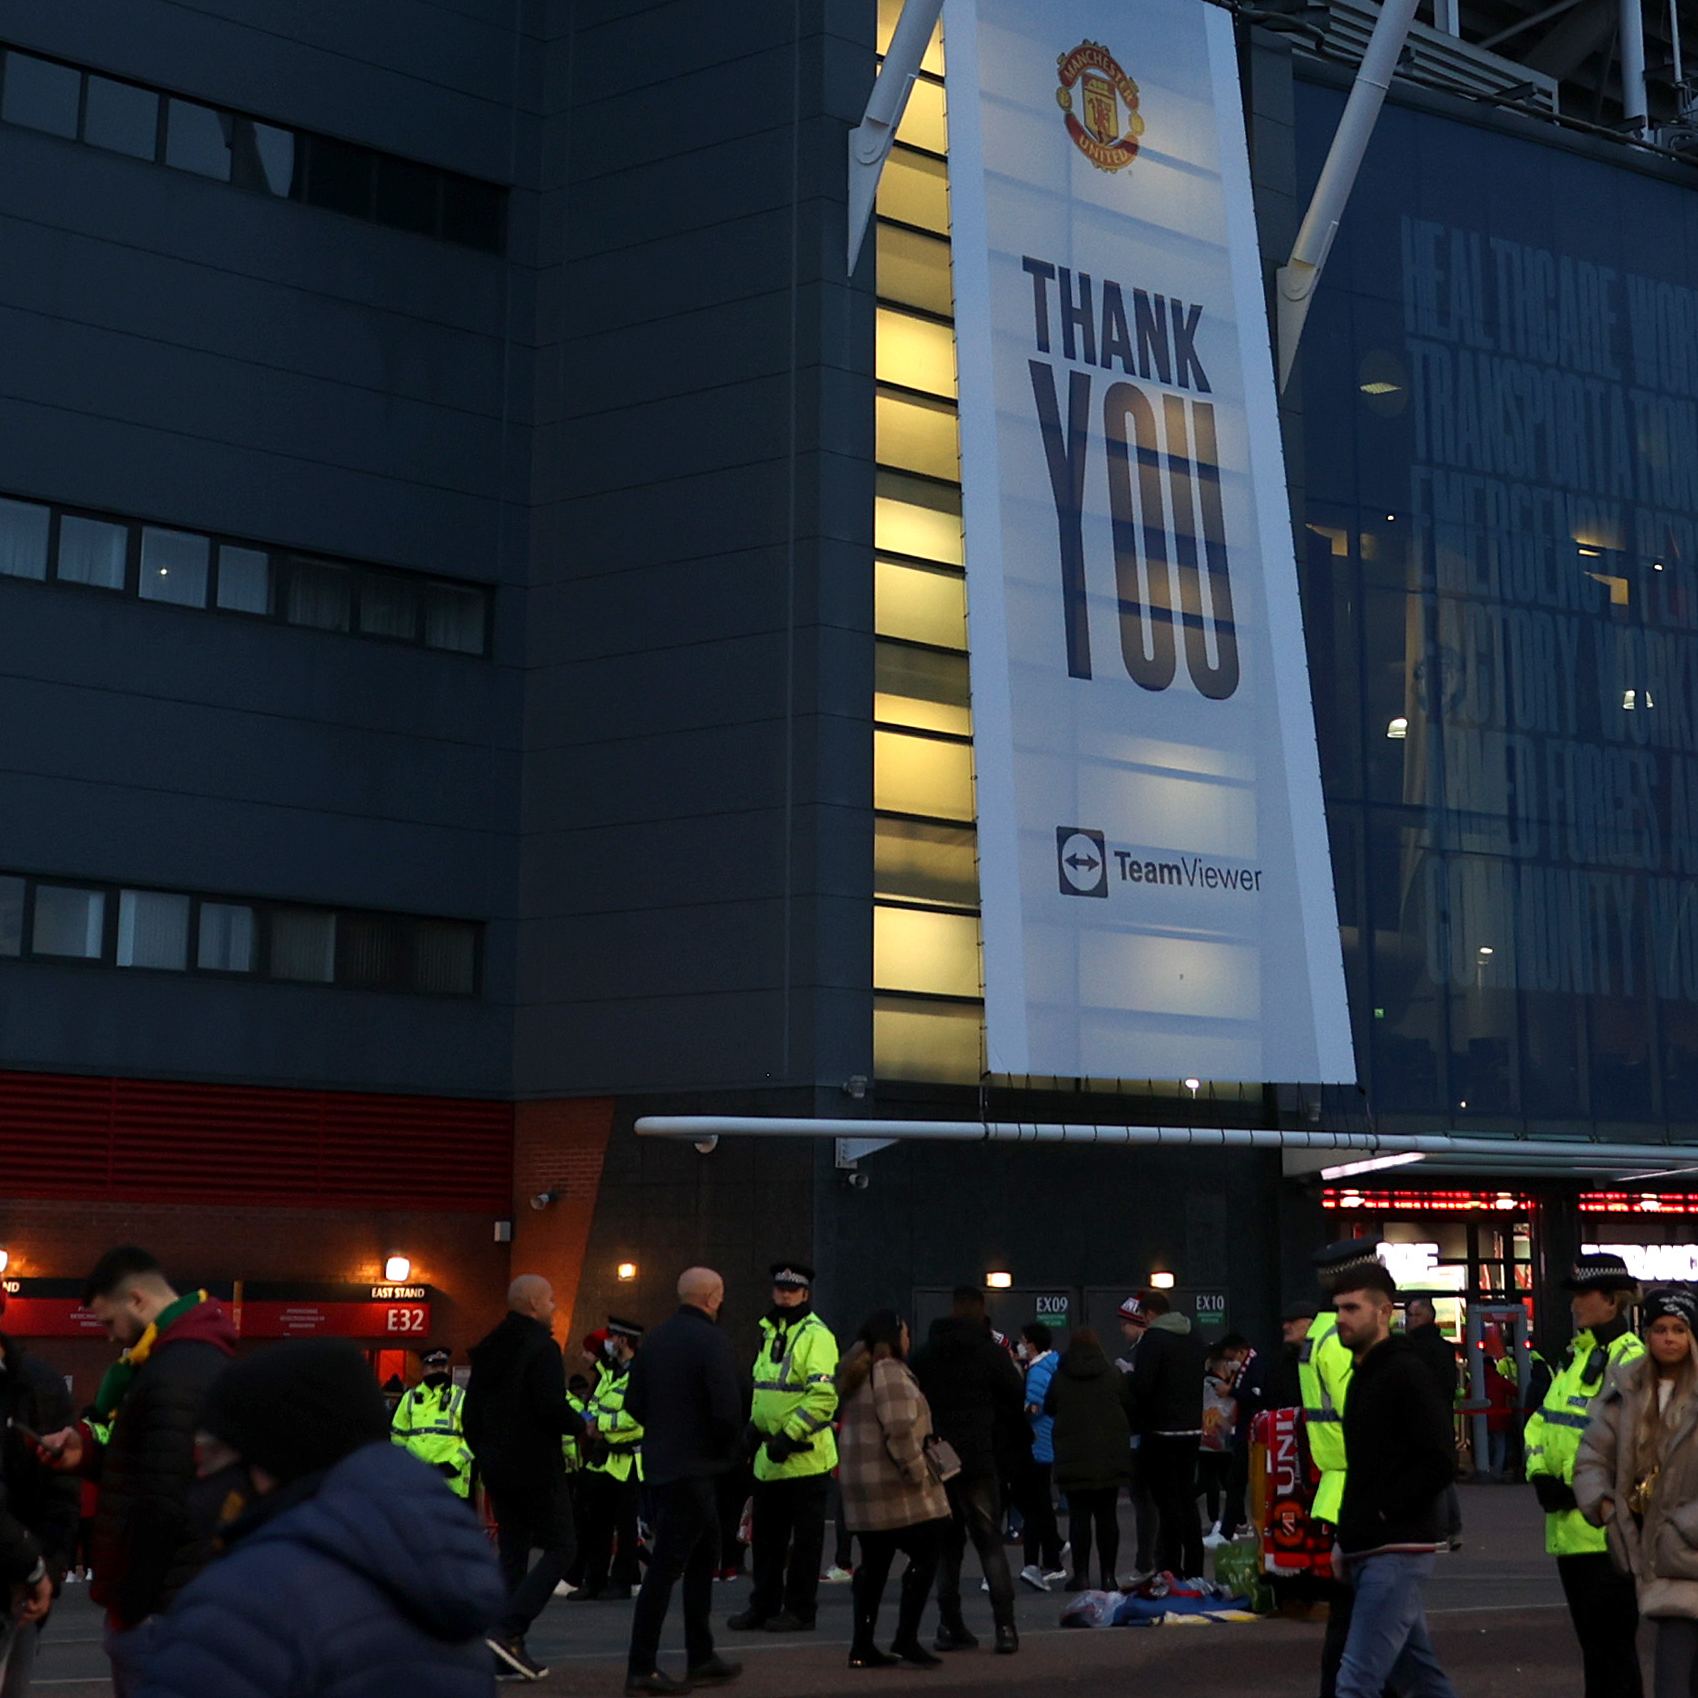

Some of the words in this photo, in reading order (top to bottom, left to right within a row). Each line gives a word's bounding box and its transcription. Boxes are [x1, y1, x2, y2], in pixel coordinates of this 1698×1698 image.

[1063, 49, 1135, 102] MANCHESTER
[1079, 135, 1128, 164] UNITED
[1022, 255, 1211, 393] THANK
[1028, 359, 1239, 700] YOU
[1114, 850, 1262, 892] TeamViewer
[371, 1287, 393, 1299] EAST
[394, 1287, 425, 1299] STAND
[1036, 1296, 1069, 1313] EX09
[1195, 1295, 1225, 1311] EX10
[387, 1308, 425, 1332] E32
